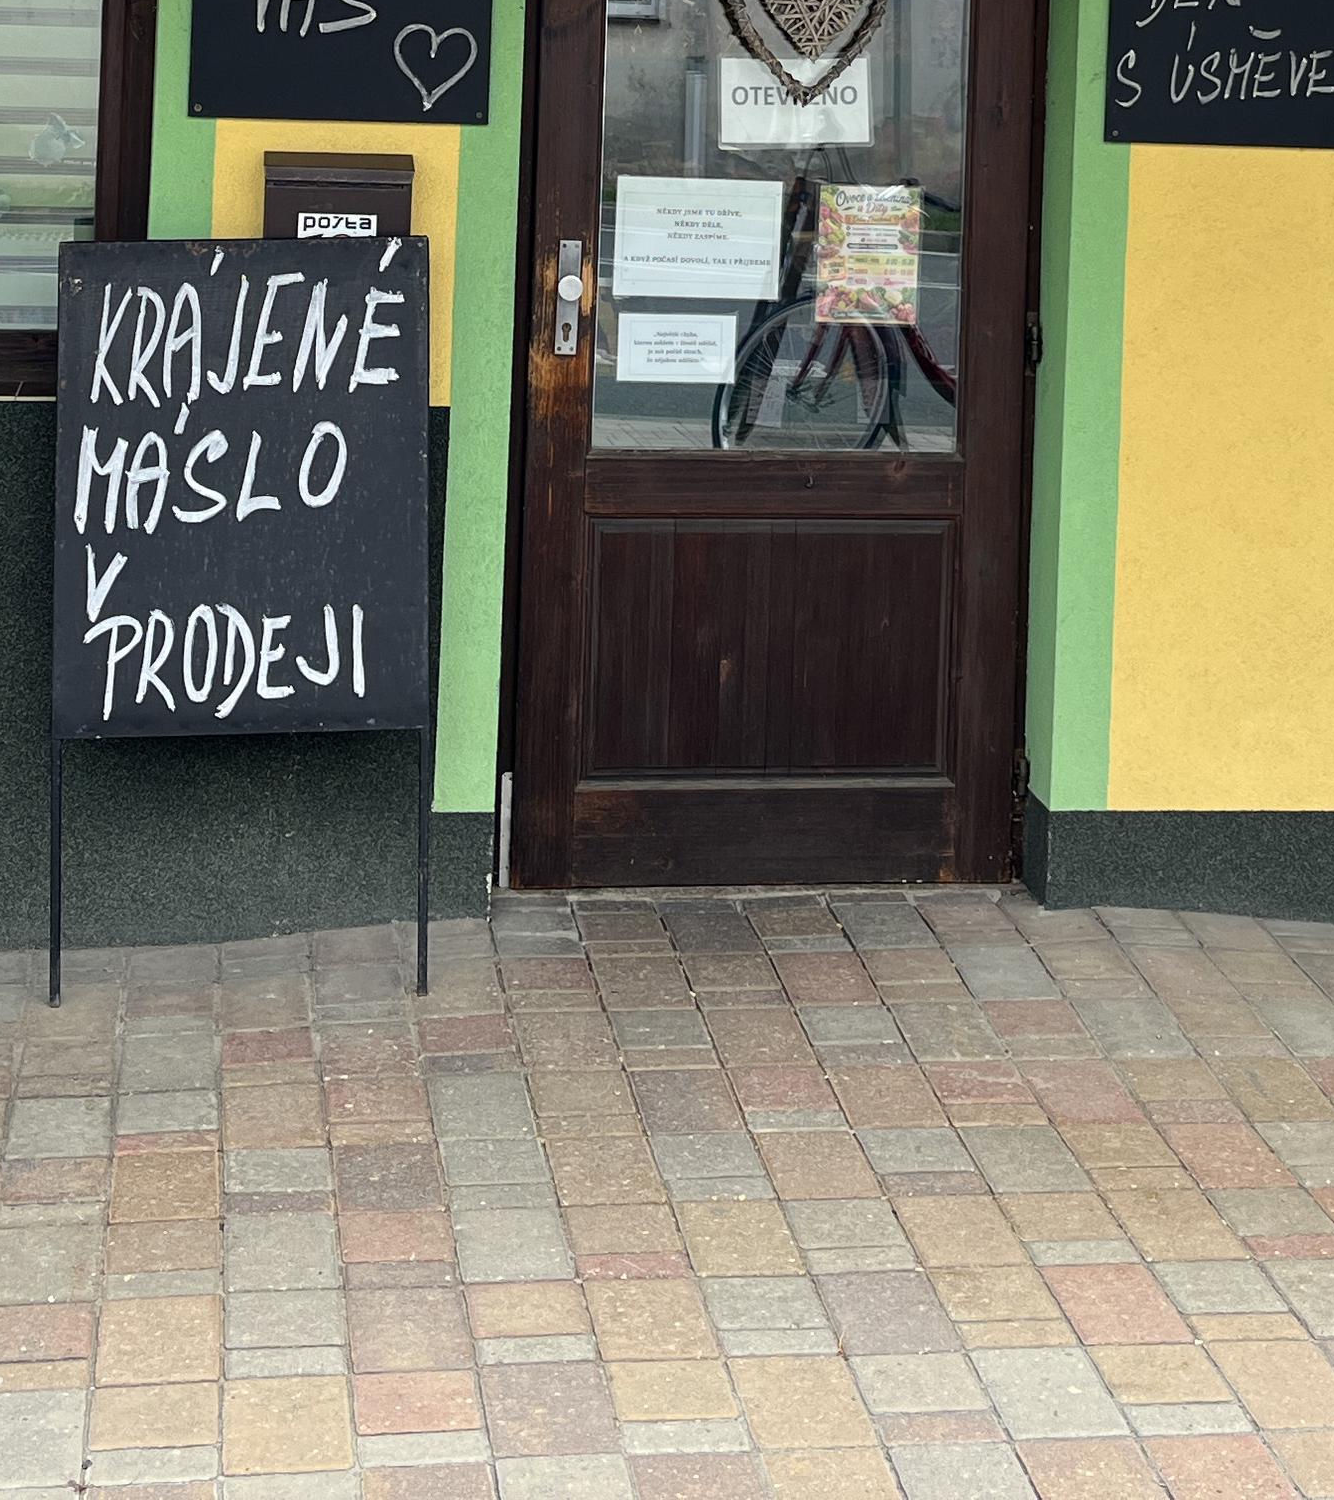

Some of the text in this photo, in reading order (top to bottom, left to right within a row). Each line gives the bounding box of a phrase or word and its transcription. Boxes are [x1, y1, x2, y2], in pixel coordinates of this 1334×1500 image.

[731, 86, 858, 105] OTEVNO
[1115, 49, 1142, 108] S
[90, 237, 406, 409] KRÁJENÉ
[73, 402, 349, 534] MÁSLO
[82, 601, 365, 721] PRODEJI
